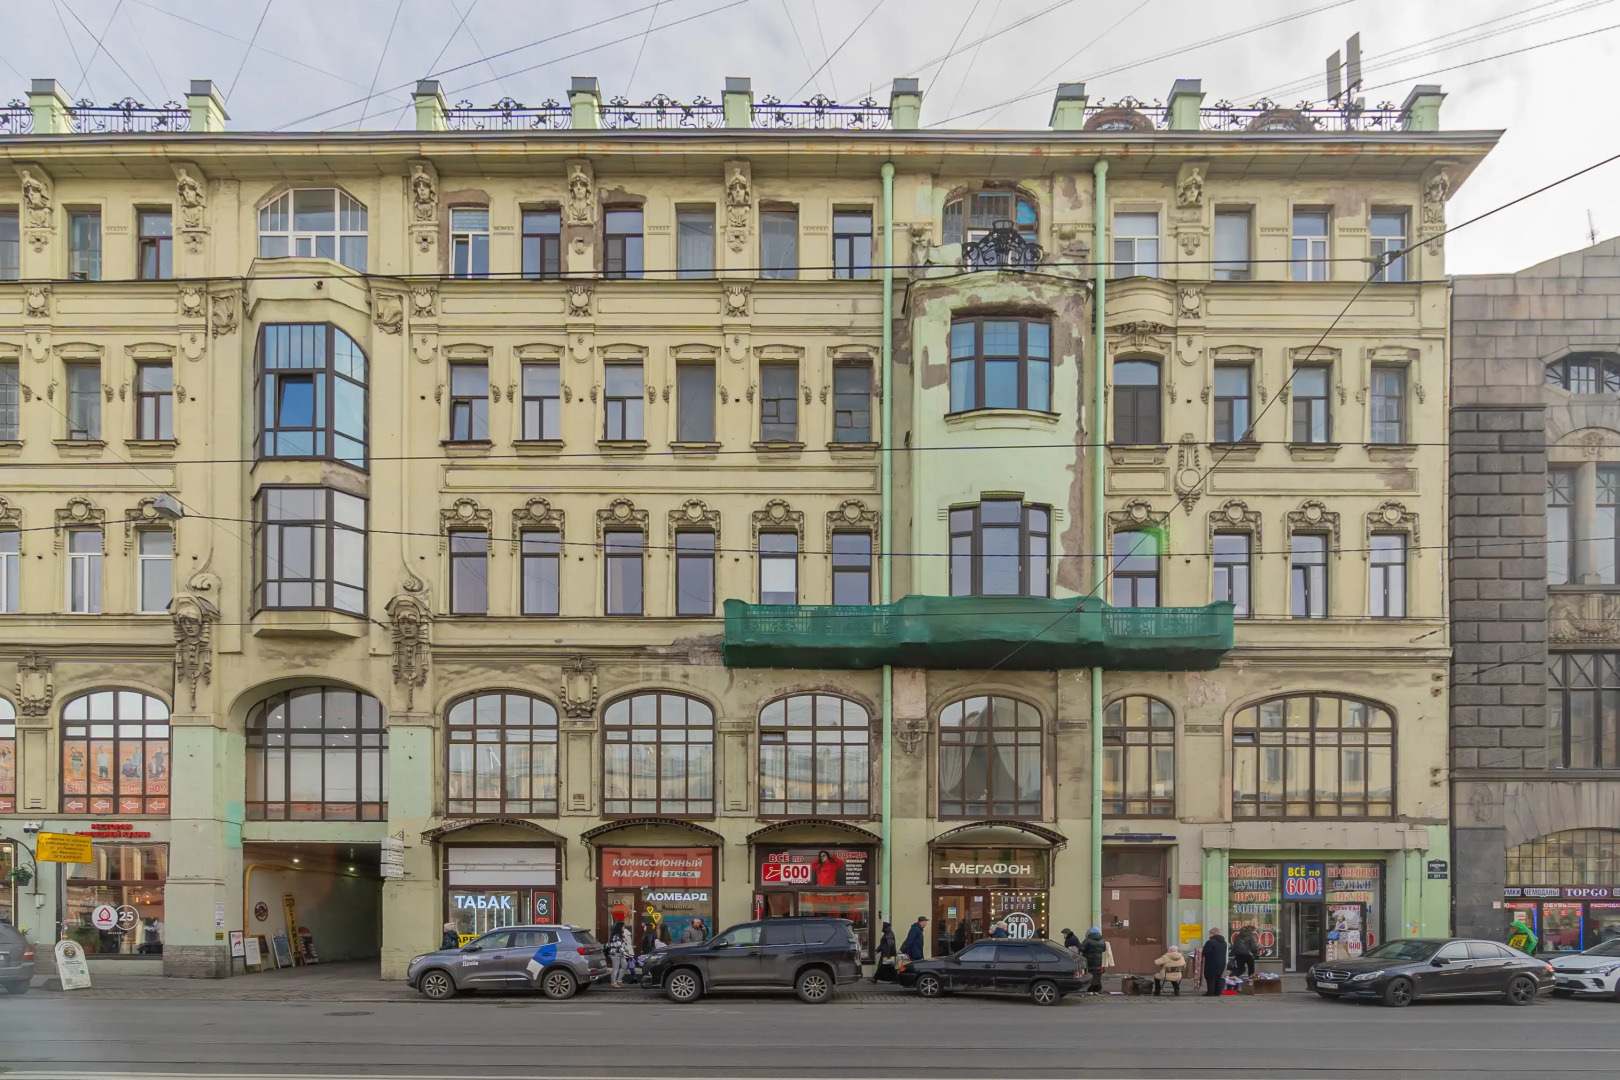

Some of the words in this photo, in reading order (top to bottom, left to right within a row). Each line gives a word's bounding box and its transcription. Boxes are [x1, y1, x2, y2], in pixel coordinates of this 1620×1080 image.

[612, 858, 702, 867] КОМИССИОННЫЙ
[768, 852, 790, 862] ВСЁ
[612, 869, 660, 877] МАГАЗИН
[782, 865, 810, 879] 600
[1228, 867, 1278, 878] КРОССОВКИ
[1287, 865, 1306, 877] ВСЁ
[1309, 869, 1321, 877] по
[1327, 867, 1379, 878] КРОССОВКИ
[1233, 879, 1272, 890] СУМКИ
[1286, 877, 1317, 896] 600
[1333, 879, 1373, 890] СУМКИ
[646, 892, 708, 901] ЛОМБАРД
[1234, 891, 1270, 902] ОБУВЬ
[1333, 891, 1370, 902] ОБУВЬ
[1504, 888, 1520, 896] УМКИ
[1524, 888, 1559, 897] ЧЕМОДАНЫ
[1565, 888, 1608, 897] TOPGO
[454, 895, 511, 909] ТАБАК
[1233, 903, 1272, 915] ЗОНТЫ
[118, 911, 134, 922] 25
[1348, 941, 1361, 950] 600
